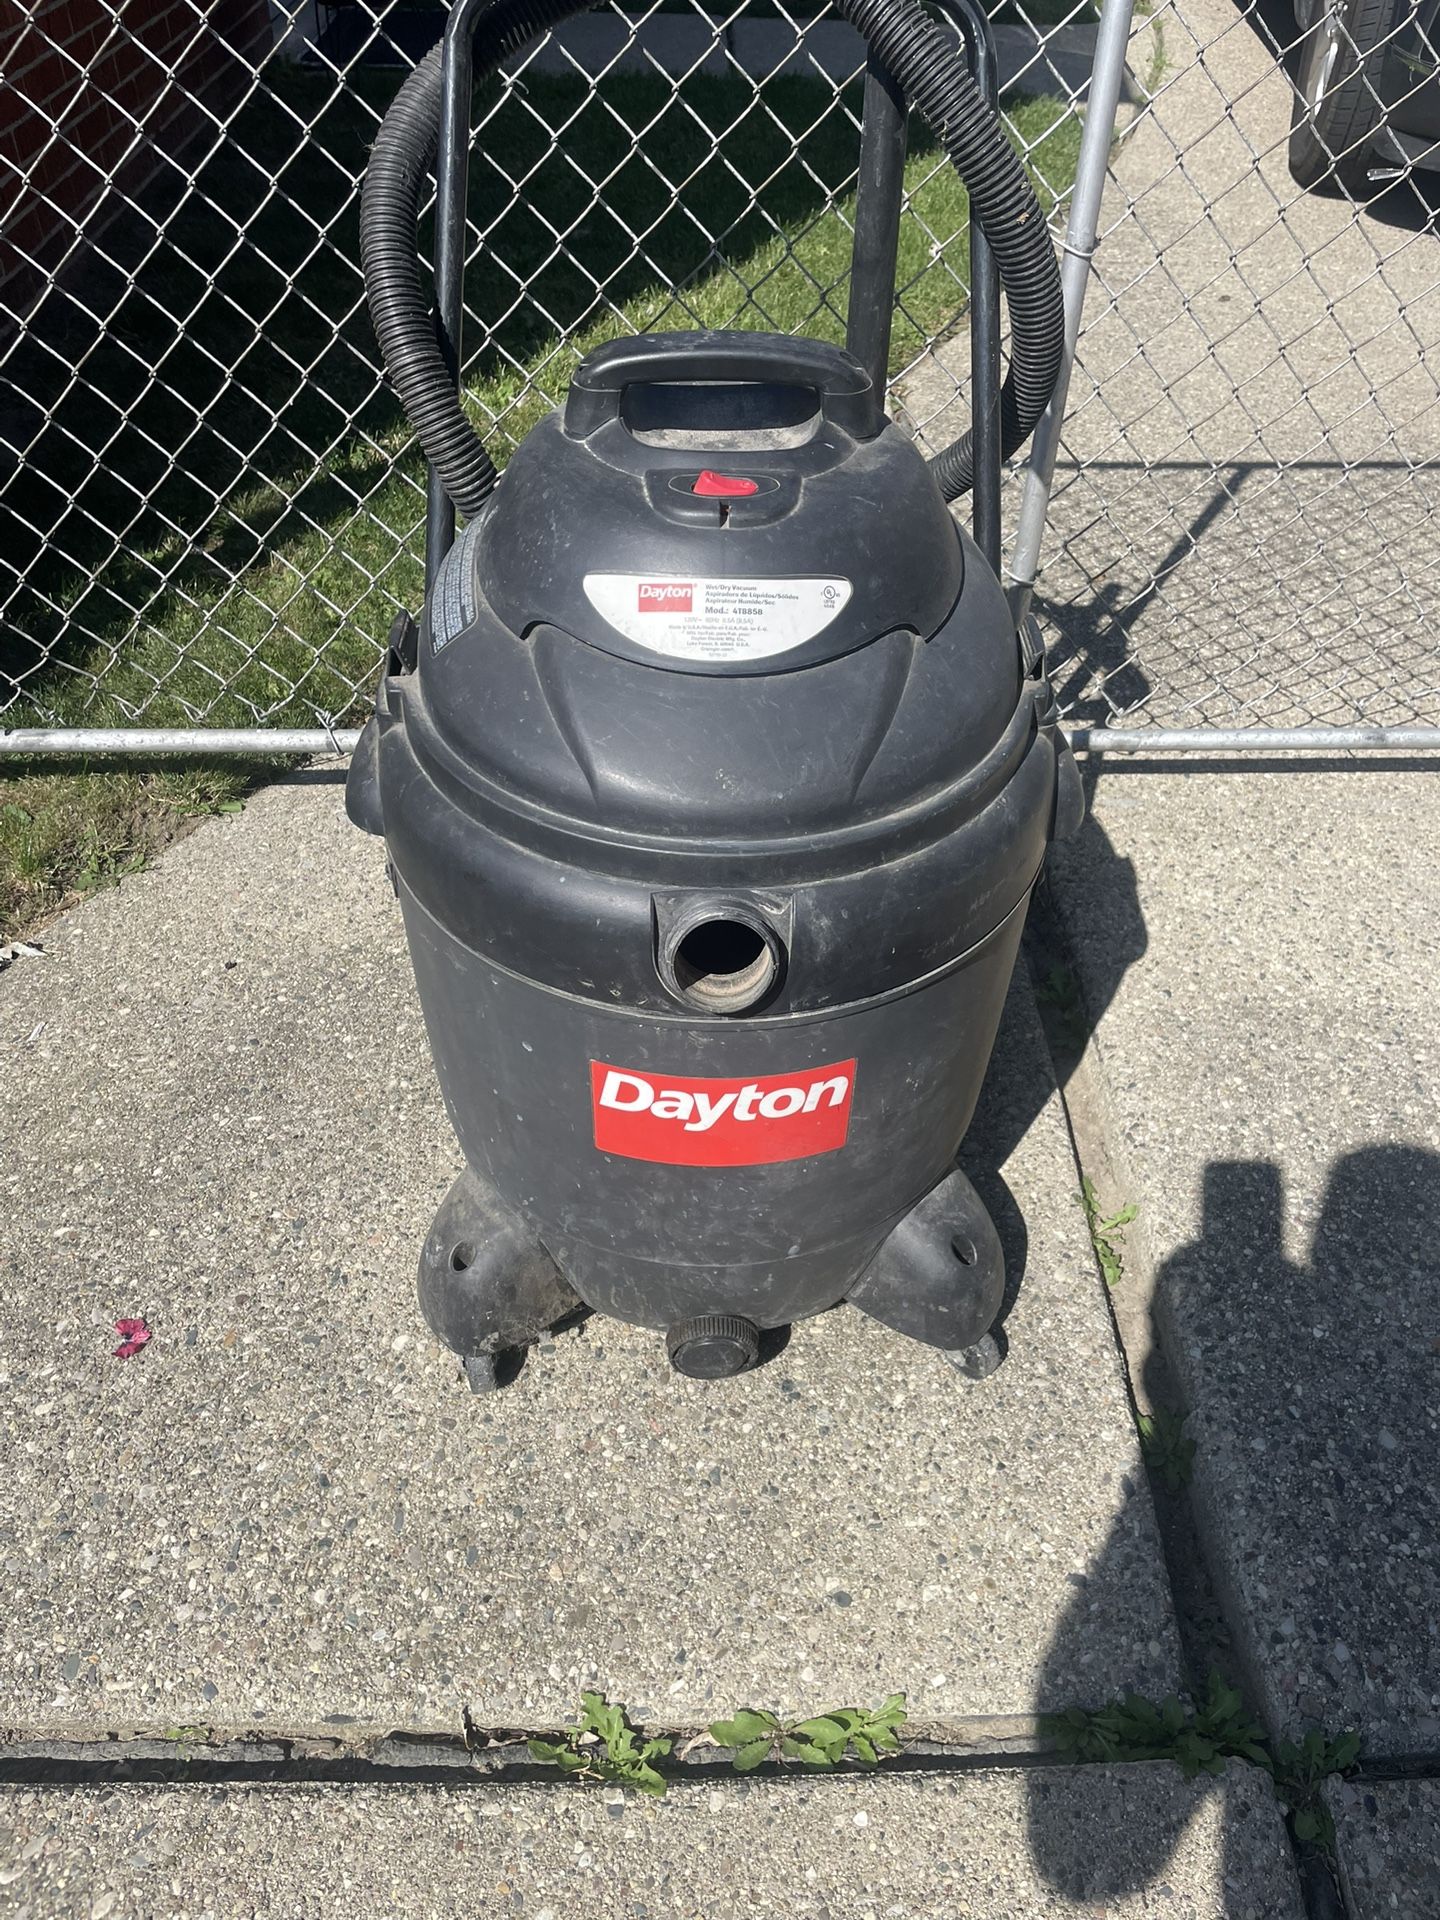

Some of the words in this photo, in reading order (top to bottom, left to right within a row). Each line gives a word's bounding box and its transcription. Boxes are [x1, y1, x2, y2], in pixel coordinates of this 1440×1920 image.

[639, 585, 692, 601] Dayton
[732, 584, 757, 592] Vacuum
[599, 1070, 850, 1133] Dayton
